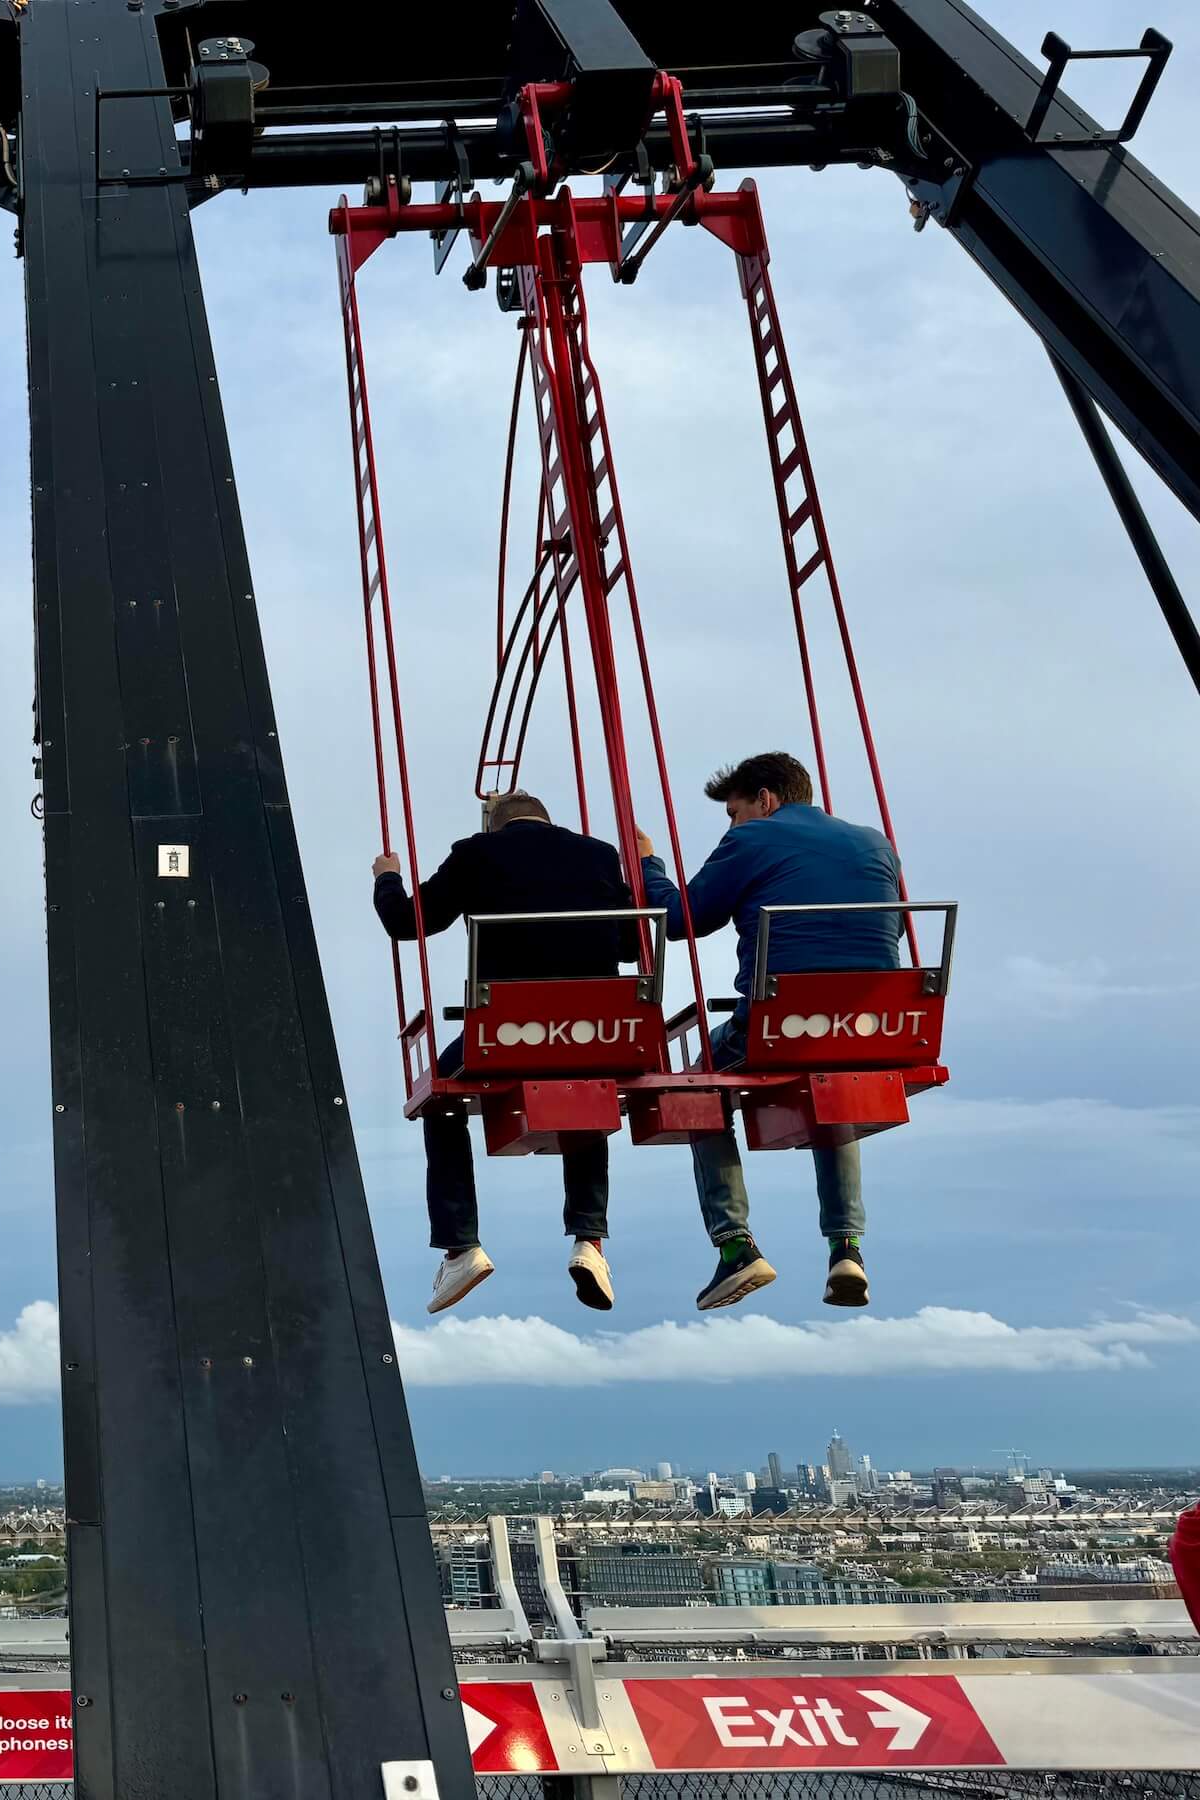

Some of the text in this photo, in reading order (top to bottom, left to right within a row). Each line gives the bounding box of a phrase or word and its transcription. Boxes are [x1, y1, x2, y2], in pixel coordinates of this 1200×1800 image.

[477, 1018, 643, 1047] LOOKOUT
[762, 1011, 927, 1039] LOOKOUT
[701, 1695, 860, 1748] Exit
